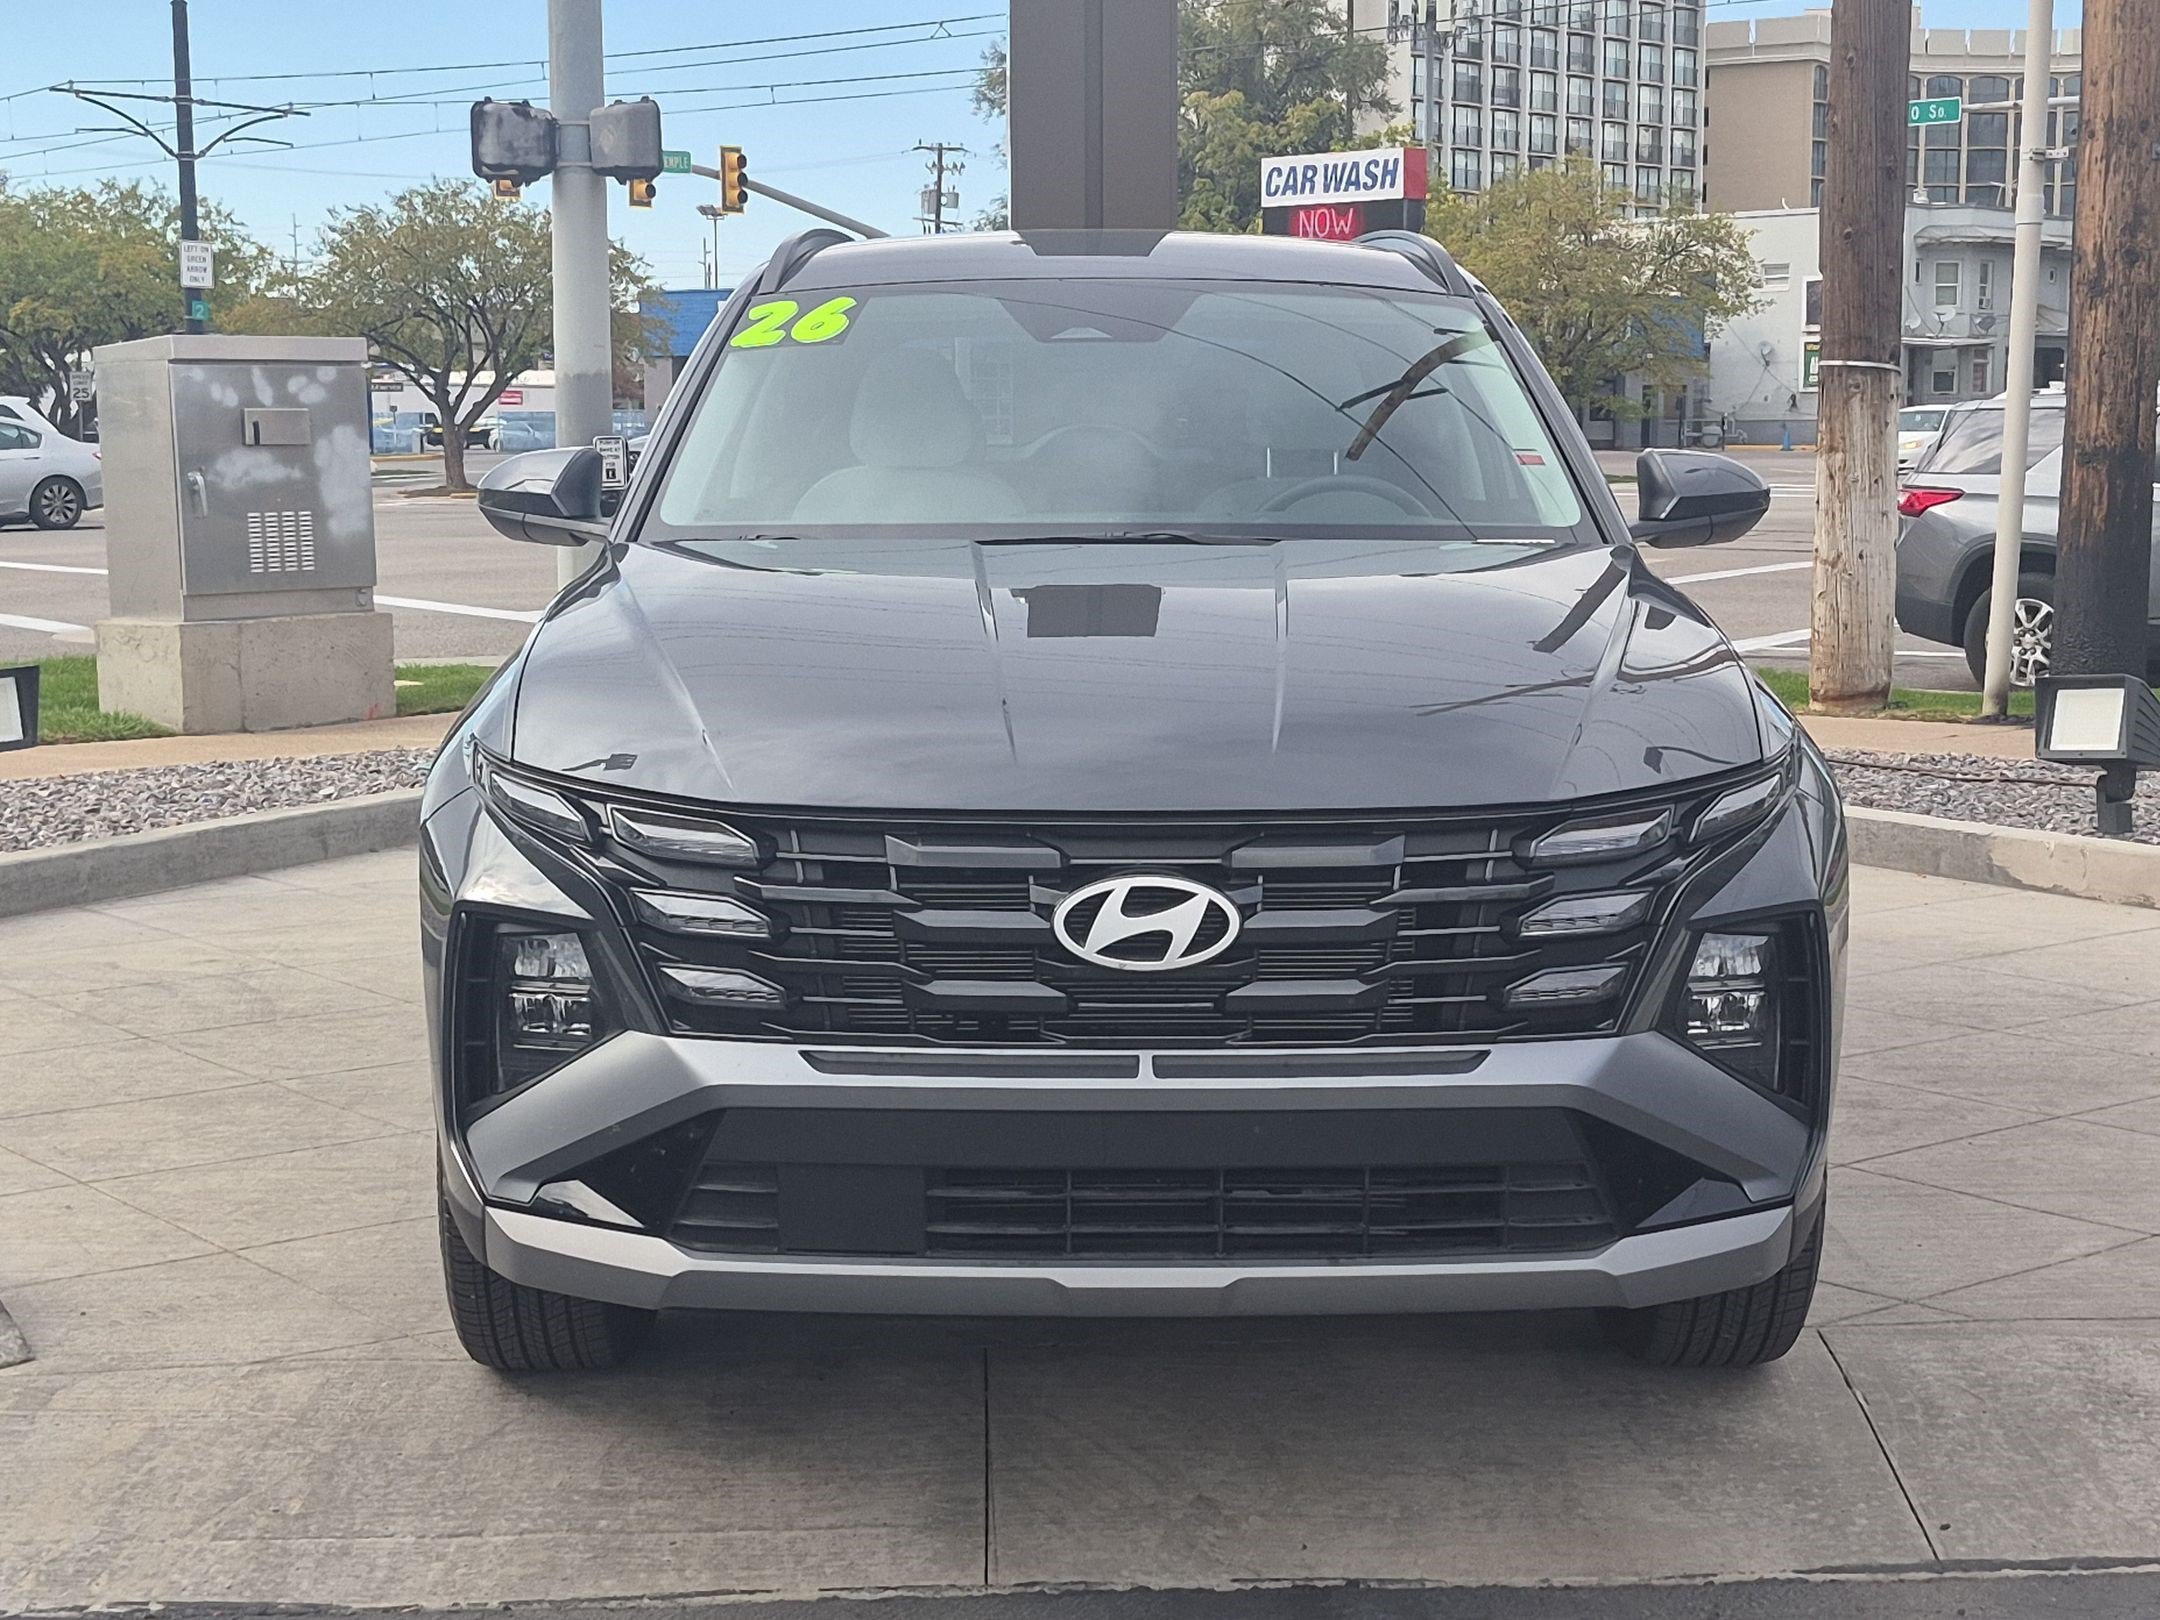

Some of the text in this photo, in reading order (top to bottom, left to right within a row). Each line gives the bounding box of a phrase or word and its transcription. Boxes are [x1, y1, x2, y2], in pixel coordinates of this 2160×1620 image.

[1265, 157, 1399, 198] CAR WASH
[1300, 208, 1353, 238] NOW
[195, 304, 204, 318] 2
[730, 297, 857, 348] 26
[73, 387, 89, 398] 25
